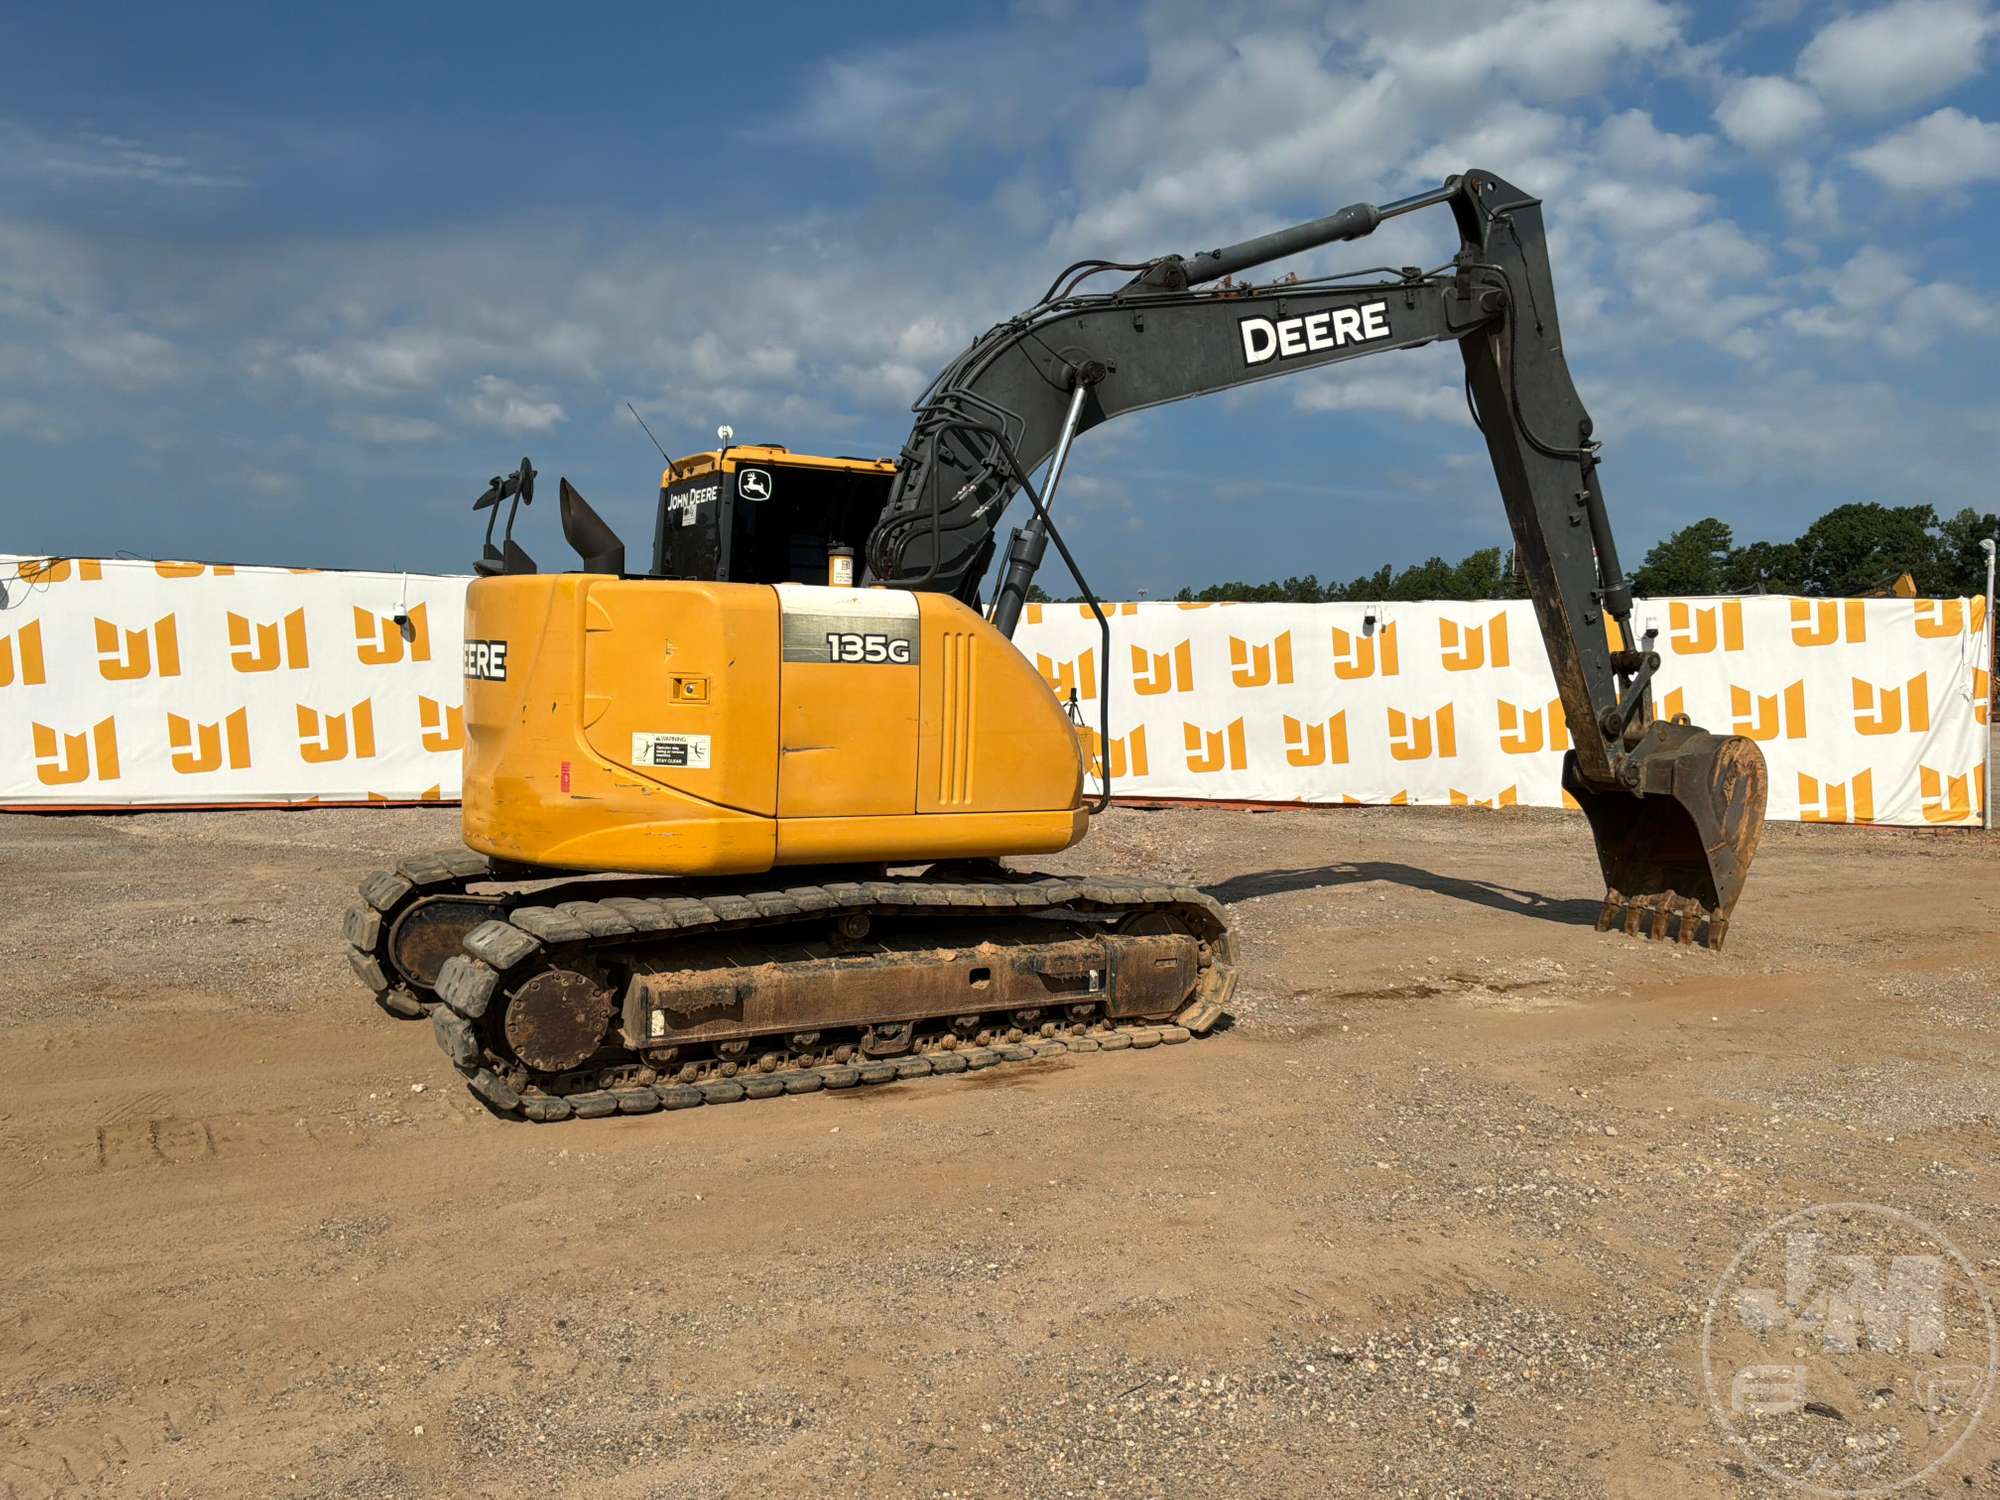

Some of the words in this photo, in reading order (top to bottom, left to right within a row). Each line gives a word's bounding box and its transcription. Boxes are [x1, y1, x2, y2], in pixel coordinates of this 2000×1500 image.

[1240, 301, 1390, 363] DEERE
[668, 493, 690, 511] JOHN
[690, 486, 718, 506] DEERE
[828, 634, 909, 663] 135G
